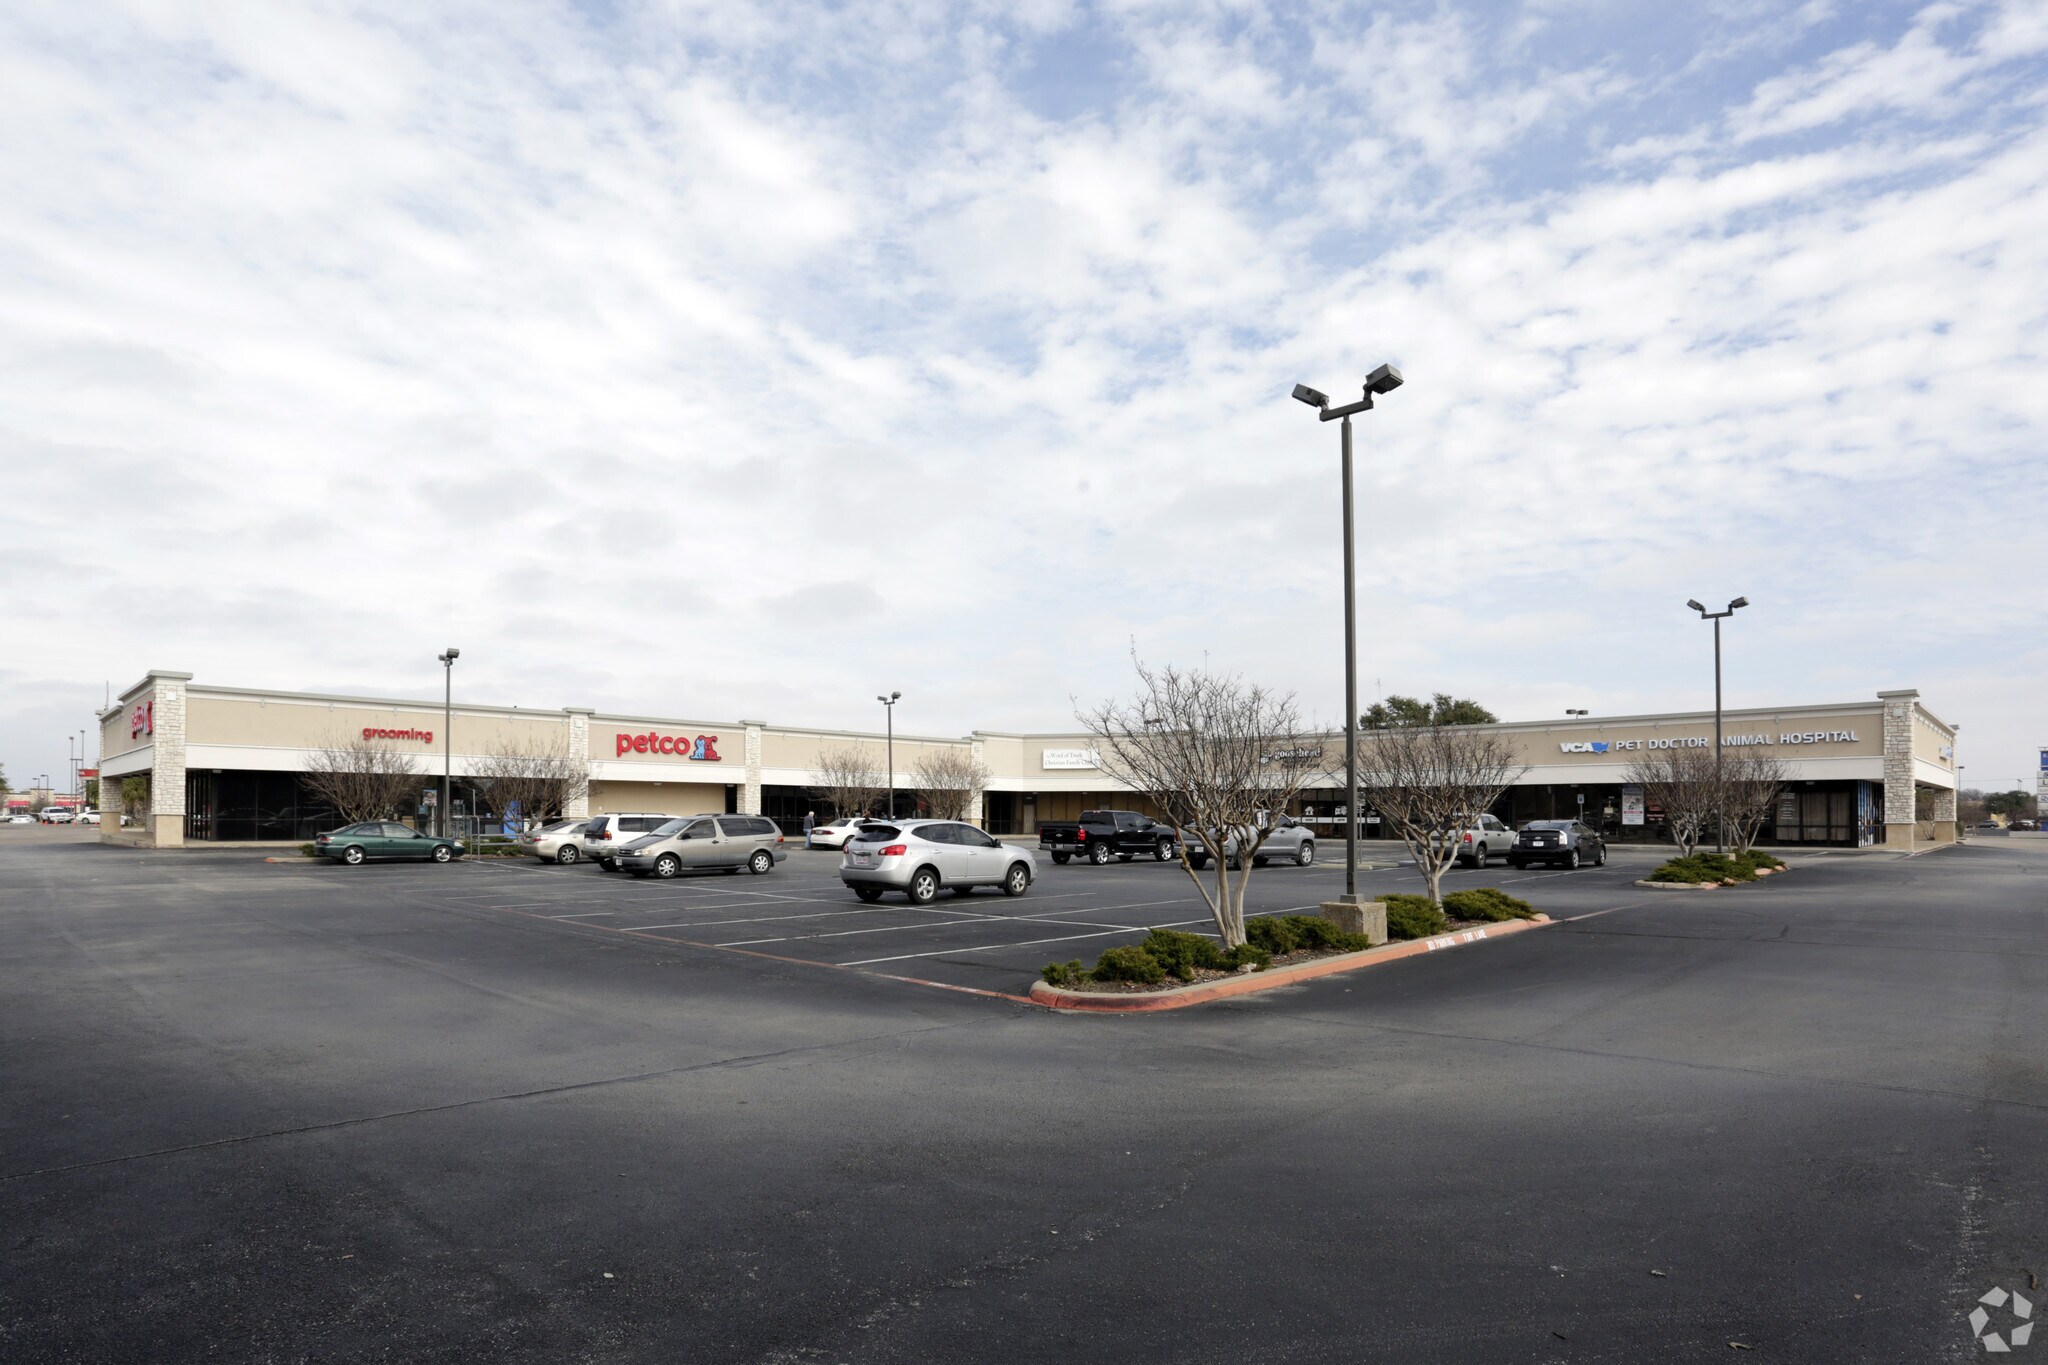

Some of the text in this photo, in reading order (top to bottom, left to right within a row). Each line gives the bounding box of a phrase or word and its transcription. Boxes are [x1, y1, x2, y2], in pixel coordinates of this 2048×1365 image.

[362, 728, 433, 744] grooming
[616, 732, 691, 758] petco
[1559, 742, 1593, 753] VCA
[1615, 740, 1643, 750] PET
[1649, 737, 1709, 750] DOCTOR
[1780, 730, 1860, 745] HOSPITAL
